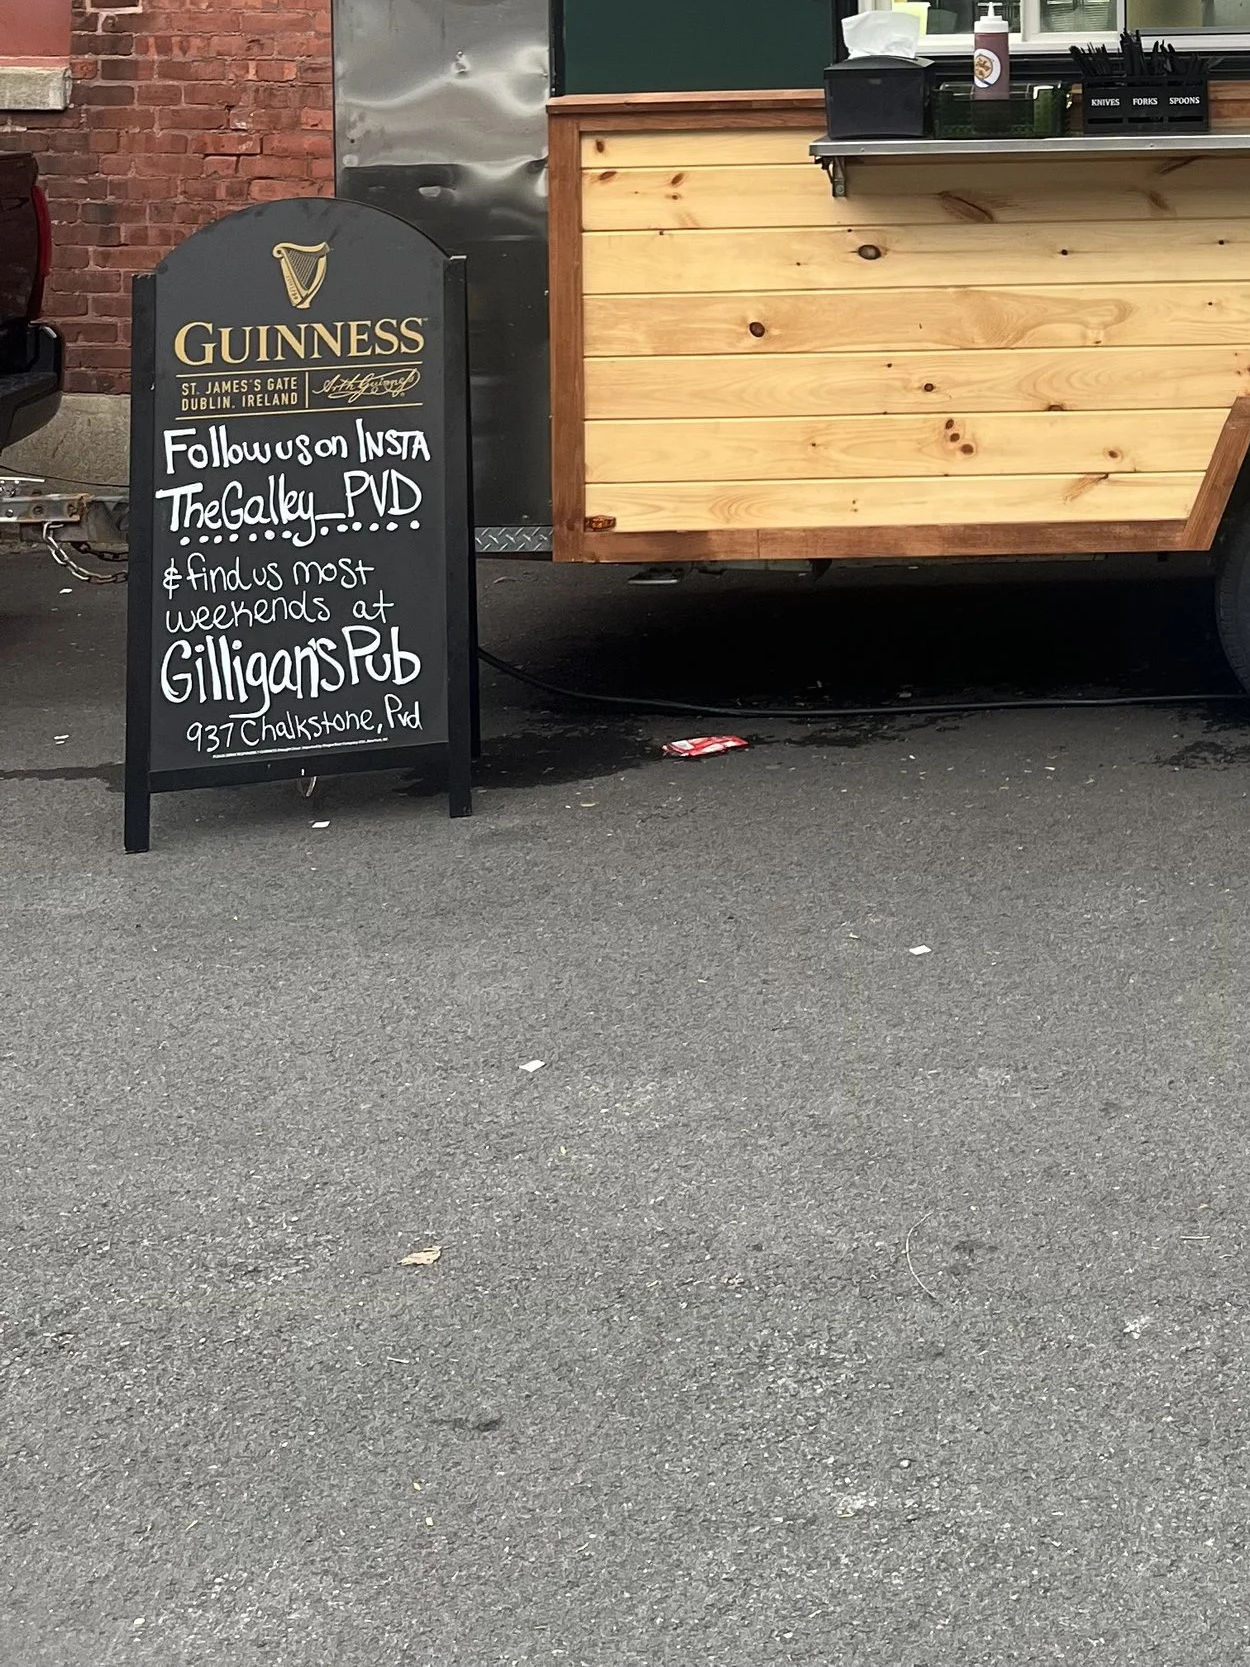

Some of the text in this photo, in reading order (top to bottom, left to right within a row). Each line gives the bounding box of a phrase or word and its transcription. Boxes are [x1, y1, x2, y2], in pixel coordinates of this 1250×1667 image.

[1091, 96, 1200, 107] KNIVES FORKS SPOONS
[174, 317, 425, 366] GUINNESS
[242, 391, 298, 408] IRELAND
[267, 376, 298, 391] GATE
[163, 418, 431, 474] Follow us on INSTA
[186, 552, 252, 593] find
[252, 562, 283, 591] us
[292, 558, 375, 589] most
[165, 589, 395, 633] weekends at
[341, 625, 422, 686] Pub
[186, 722, 235, 753] 937
[384, 694, 423, 731] Pvd
